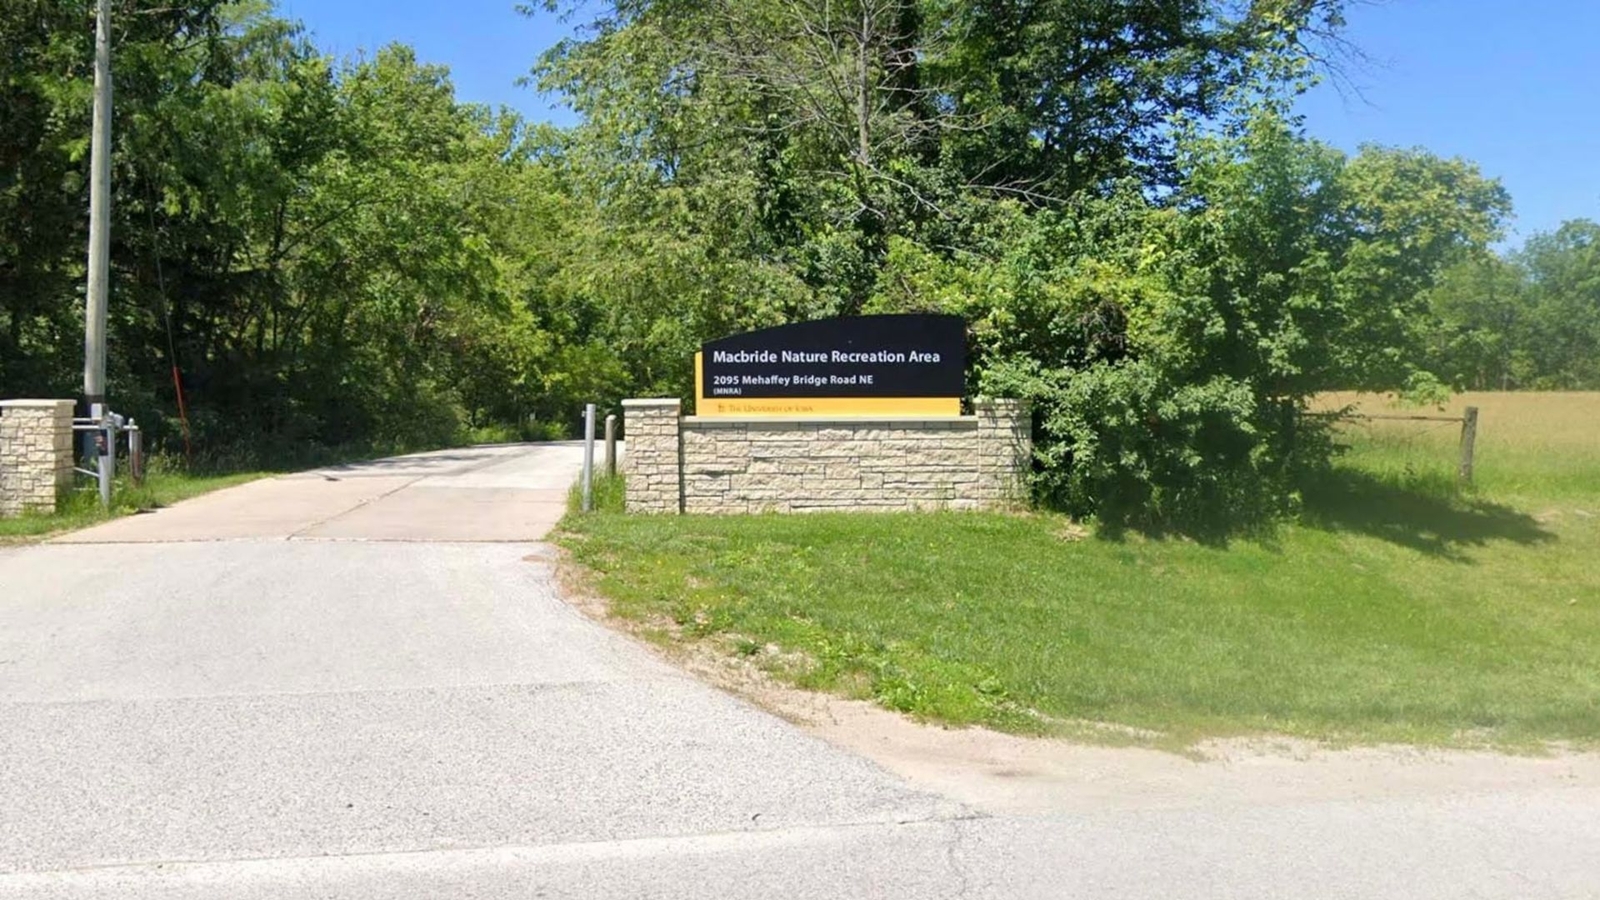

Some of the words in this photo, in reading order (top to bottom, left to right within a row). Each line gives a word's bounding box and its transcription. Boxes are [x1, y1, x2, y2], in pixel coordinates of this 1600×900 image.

[712, 349, 778, 363] Macbride
[781, 350, 829, 363] Nature
[831, 349, 906, 363] Recreation
[908, 350, 941, 363] Area
[713, 375, 740, 385] 2095
[741, 374, 791, 387] Mehaffey
[792, 374, 828, 387] Bridge
[829, 374, 857, 385] Road
[858, 375, 874, 385] NE
[712, 387, 742, 396] (MNRA)
